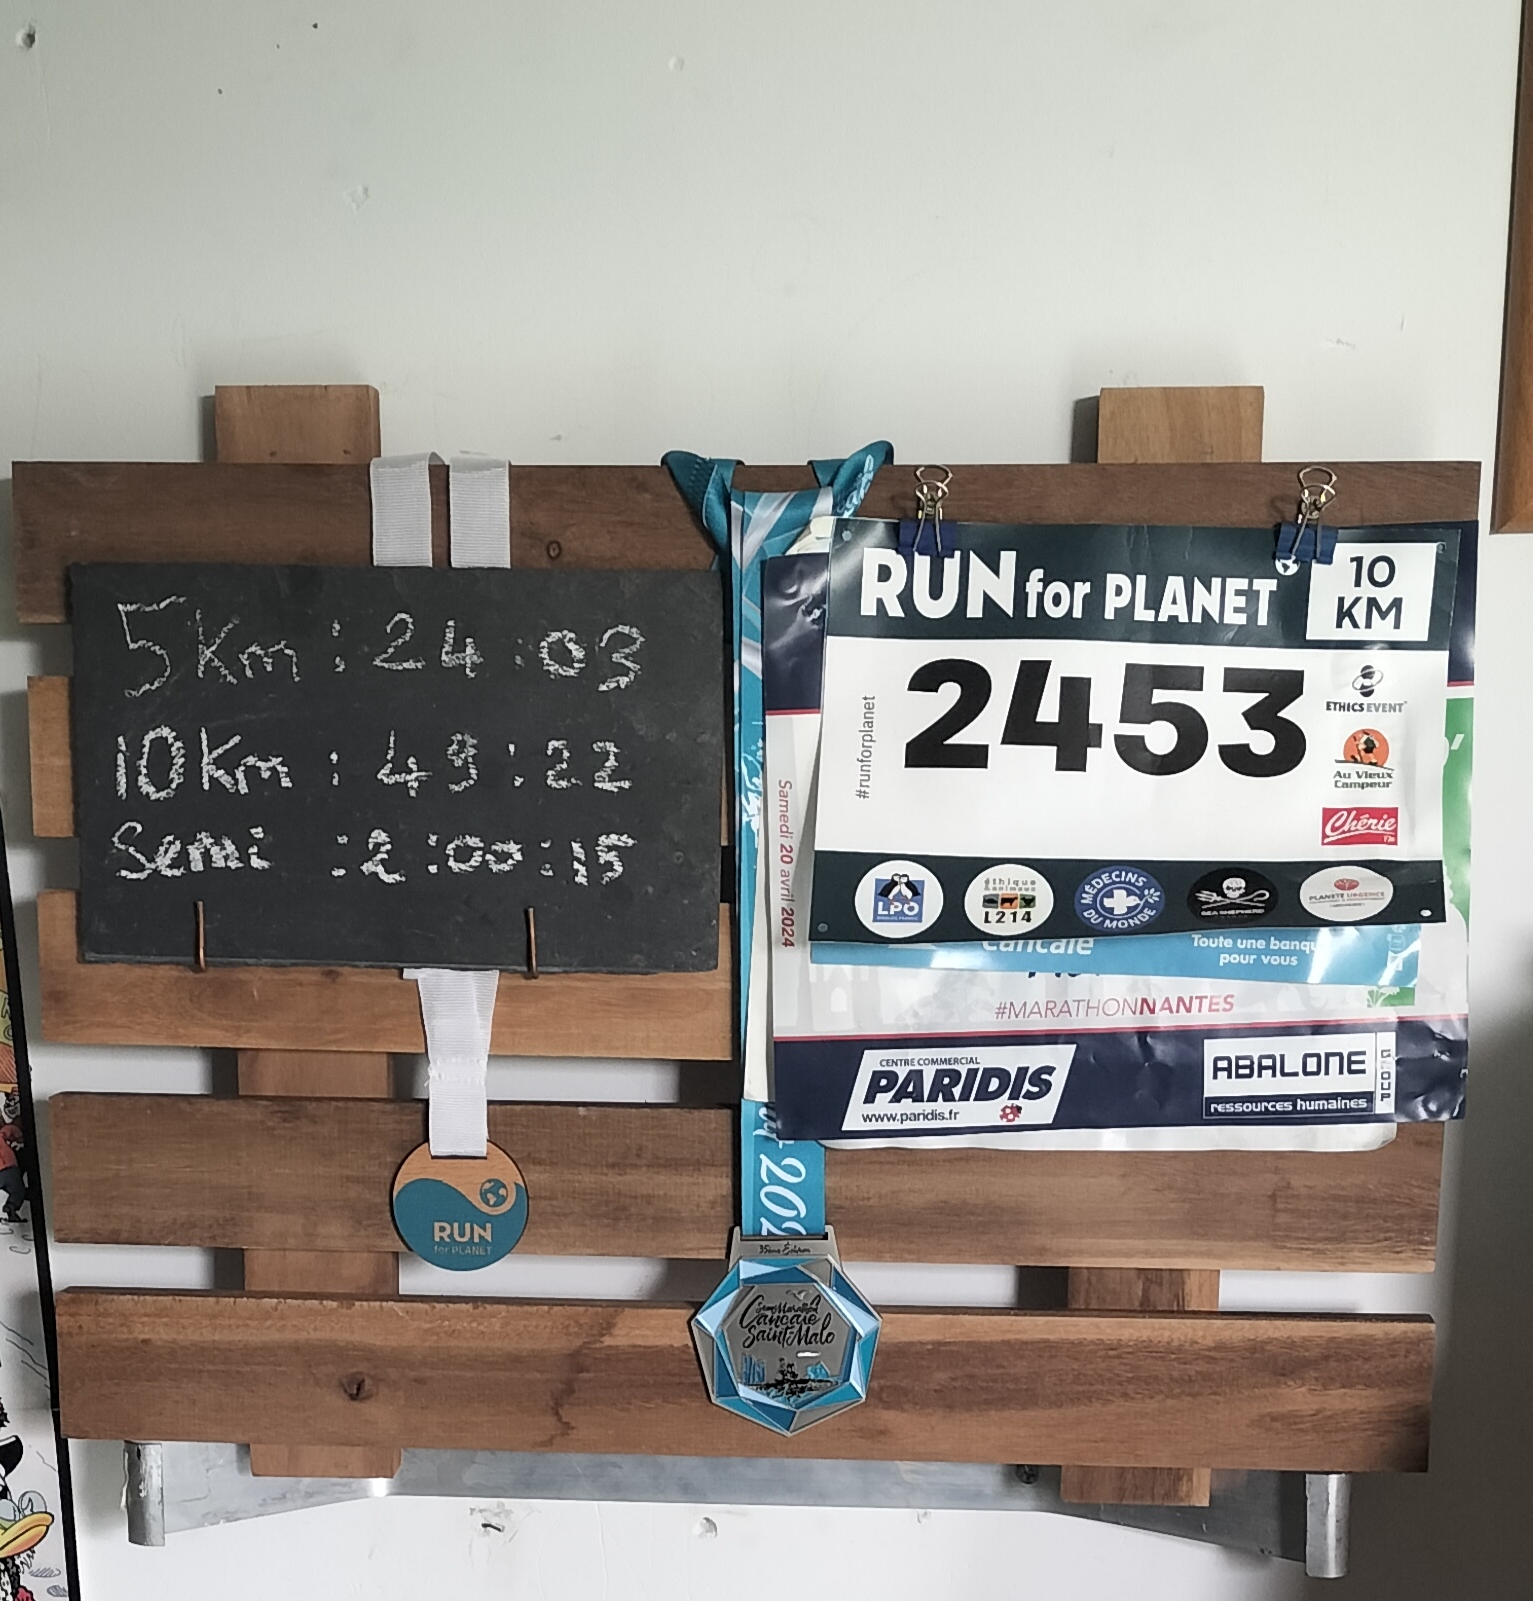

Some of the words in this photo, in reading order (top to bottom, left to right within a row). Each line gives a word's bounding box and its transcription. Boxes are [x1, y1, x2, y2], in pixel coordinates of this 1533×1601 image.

[1350, 555, 1396, 588] 10
[860, 548, 1018, 619] RUN
[1026, 569, 1091, 619] for
[1104, 573, 1278, 627] PLANET
[1336, 596, 1403, 630] KM
[904, 658, 1307, 777] 2453
[1326, 701, 1365, 712] ETHICS
[856, 694, 877, 799] #runforplanet
[1333, 771, 1351, 779] Au
[1356, 771, 1393, 779] Vieux
[1334, 780, 1392, 790] Campeur
[778, 780, 793, 839] Samedi
[1325, 811, 1397, 836] Chérie
[111, 821, 274, 881] Semi
[780, 843, 793, 864] 20
[780, 869, 795, 902] avril
[1080, 870, 1148, 905] MÉDECINS
[878, 901, 919, 916] LPO
[1083, 908, 1103, 924] DU
[1103, 907, 1157, 929] MONDE
[781, 907, 795, 947] 2024
[1192, 934, 1233, 948] Toute
[1237, 938, 1265, 949] une
[1270, 936, 1317, 954] banqu
[1219, 952, 1257, 966] pour
[1260, 955, 1298, 966] vous
[995, 994, 1234, 1019] #MARATHONNANTES
[879, 1058, 915, 1067] CENTRE
[917, 1057, 980, 1066] COMMERCIAL
[1212, 1050, 1366, 1080] ABALONE
[863, 1065, 1056, 1104] PARIDIS
[862, 1109, 959, 1124] www.paridis.fr
[1211, 1100, 1292, 1113] ressources
[1297, 1097, 1367, 1112] humaines
[434, 1222, 492, 1242] RUN
[434, 1245, 448, 1254] for
[452, 1246, 492, 1255] PLANET
